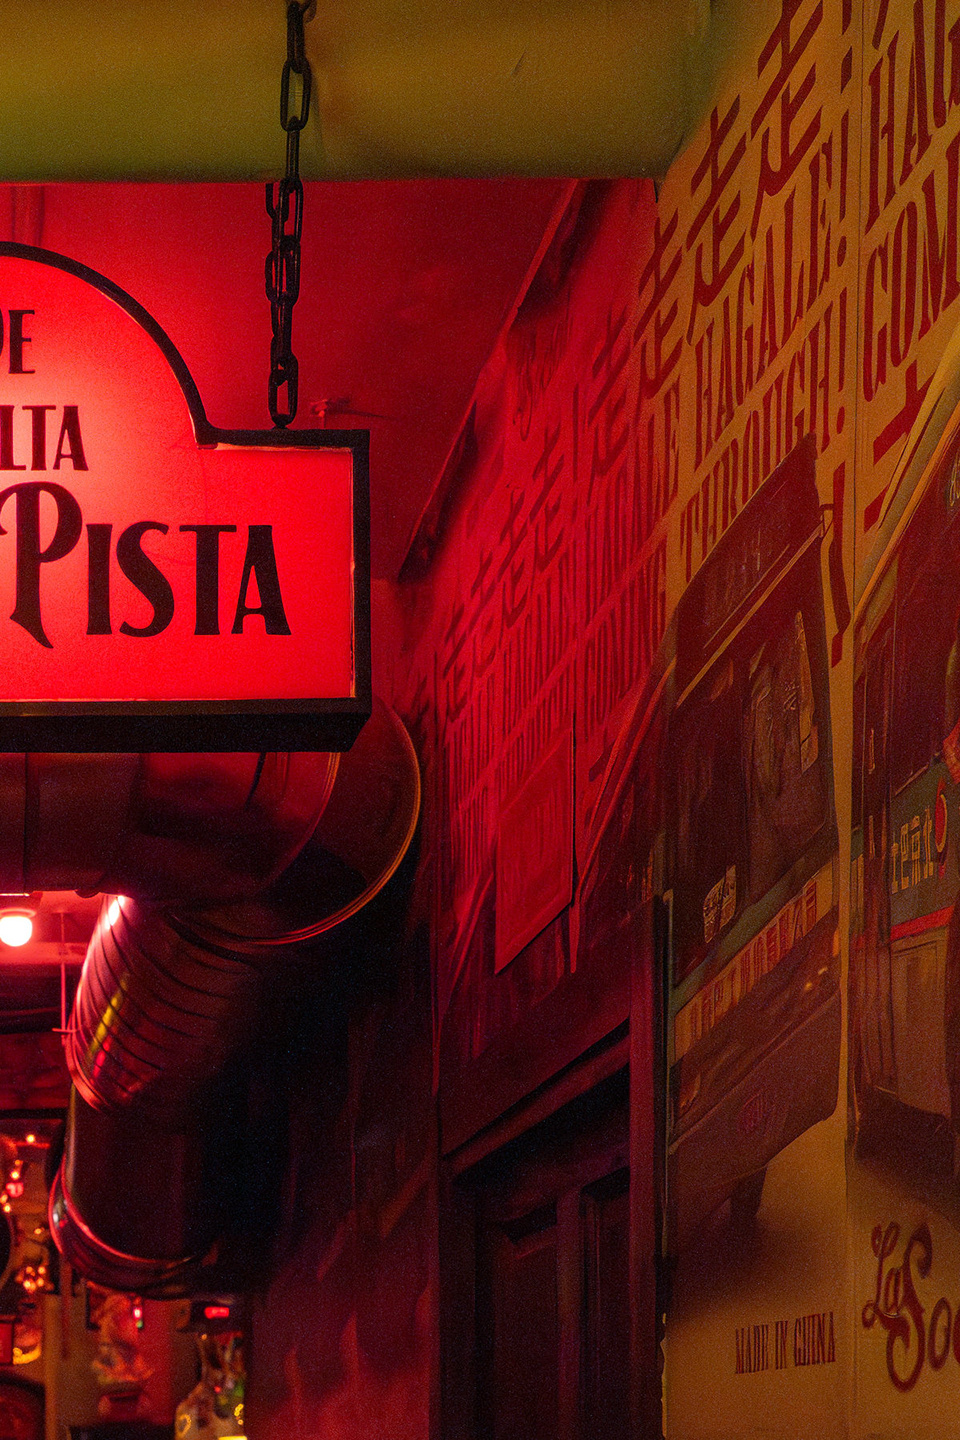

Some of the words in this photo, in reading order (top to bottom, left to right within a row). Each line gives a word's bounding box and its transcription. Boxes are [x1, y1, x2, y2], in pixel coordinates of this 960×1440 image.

[735, 1324, 769, 1375] MADE
[775, 1319, 789, 1370] IN
[793, 1311, 837, 1367] CHINA
